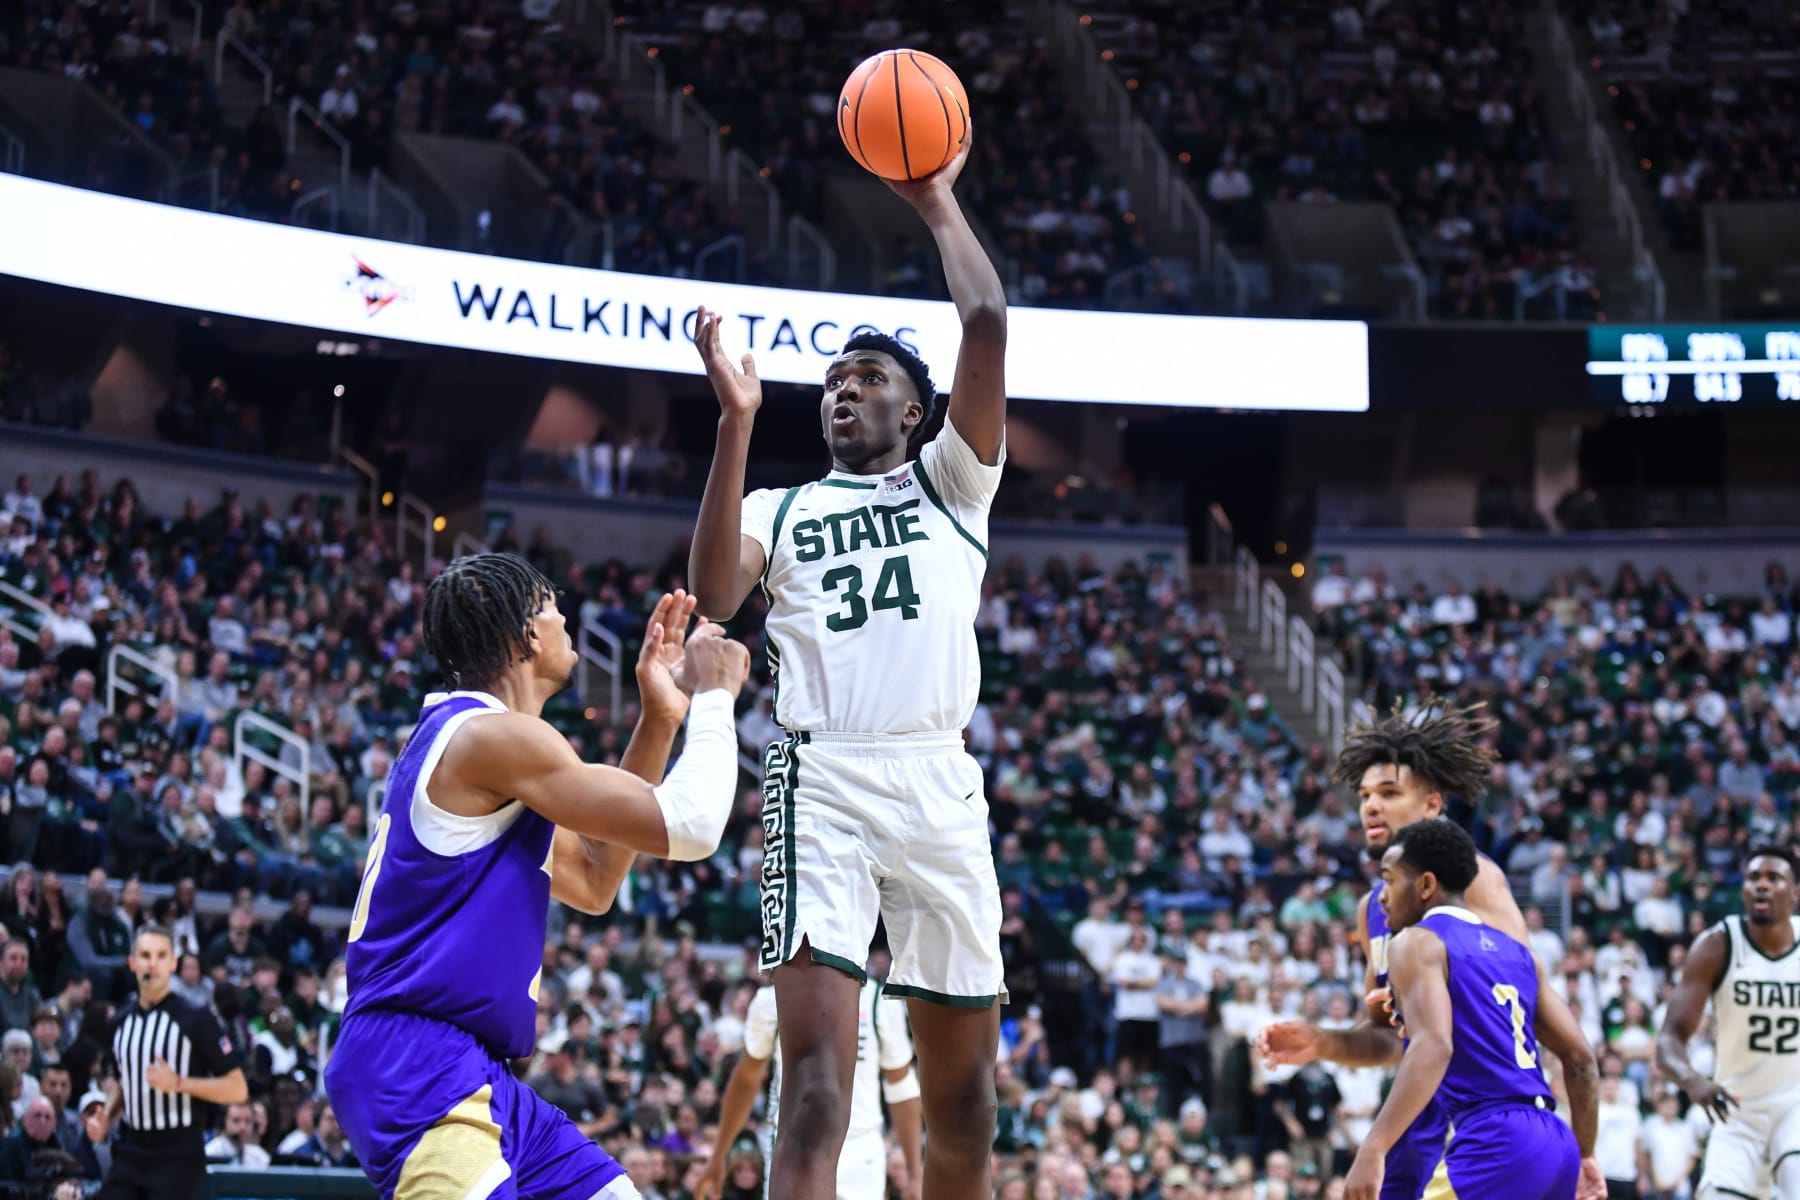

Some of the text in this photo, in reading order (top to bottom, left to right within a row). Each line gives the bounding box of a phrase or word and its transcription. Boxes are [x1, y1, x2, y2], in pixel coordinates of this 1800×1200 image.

[738, 314, 920, 357] TACS
[792, 498, 931, 563] STATE
[821, 555, 921, 633] 34
[1733, 980, 1800, 1008] STAT
[1748, 1014, 1800, 1055] 22
